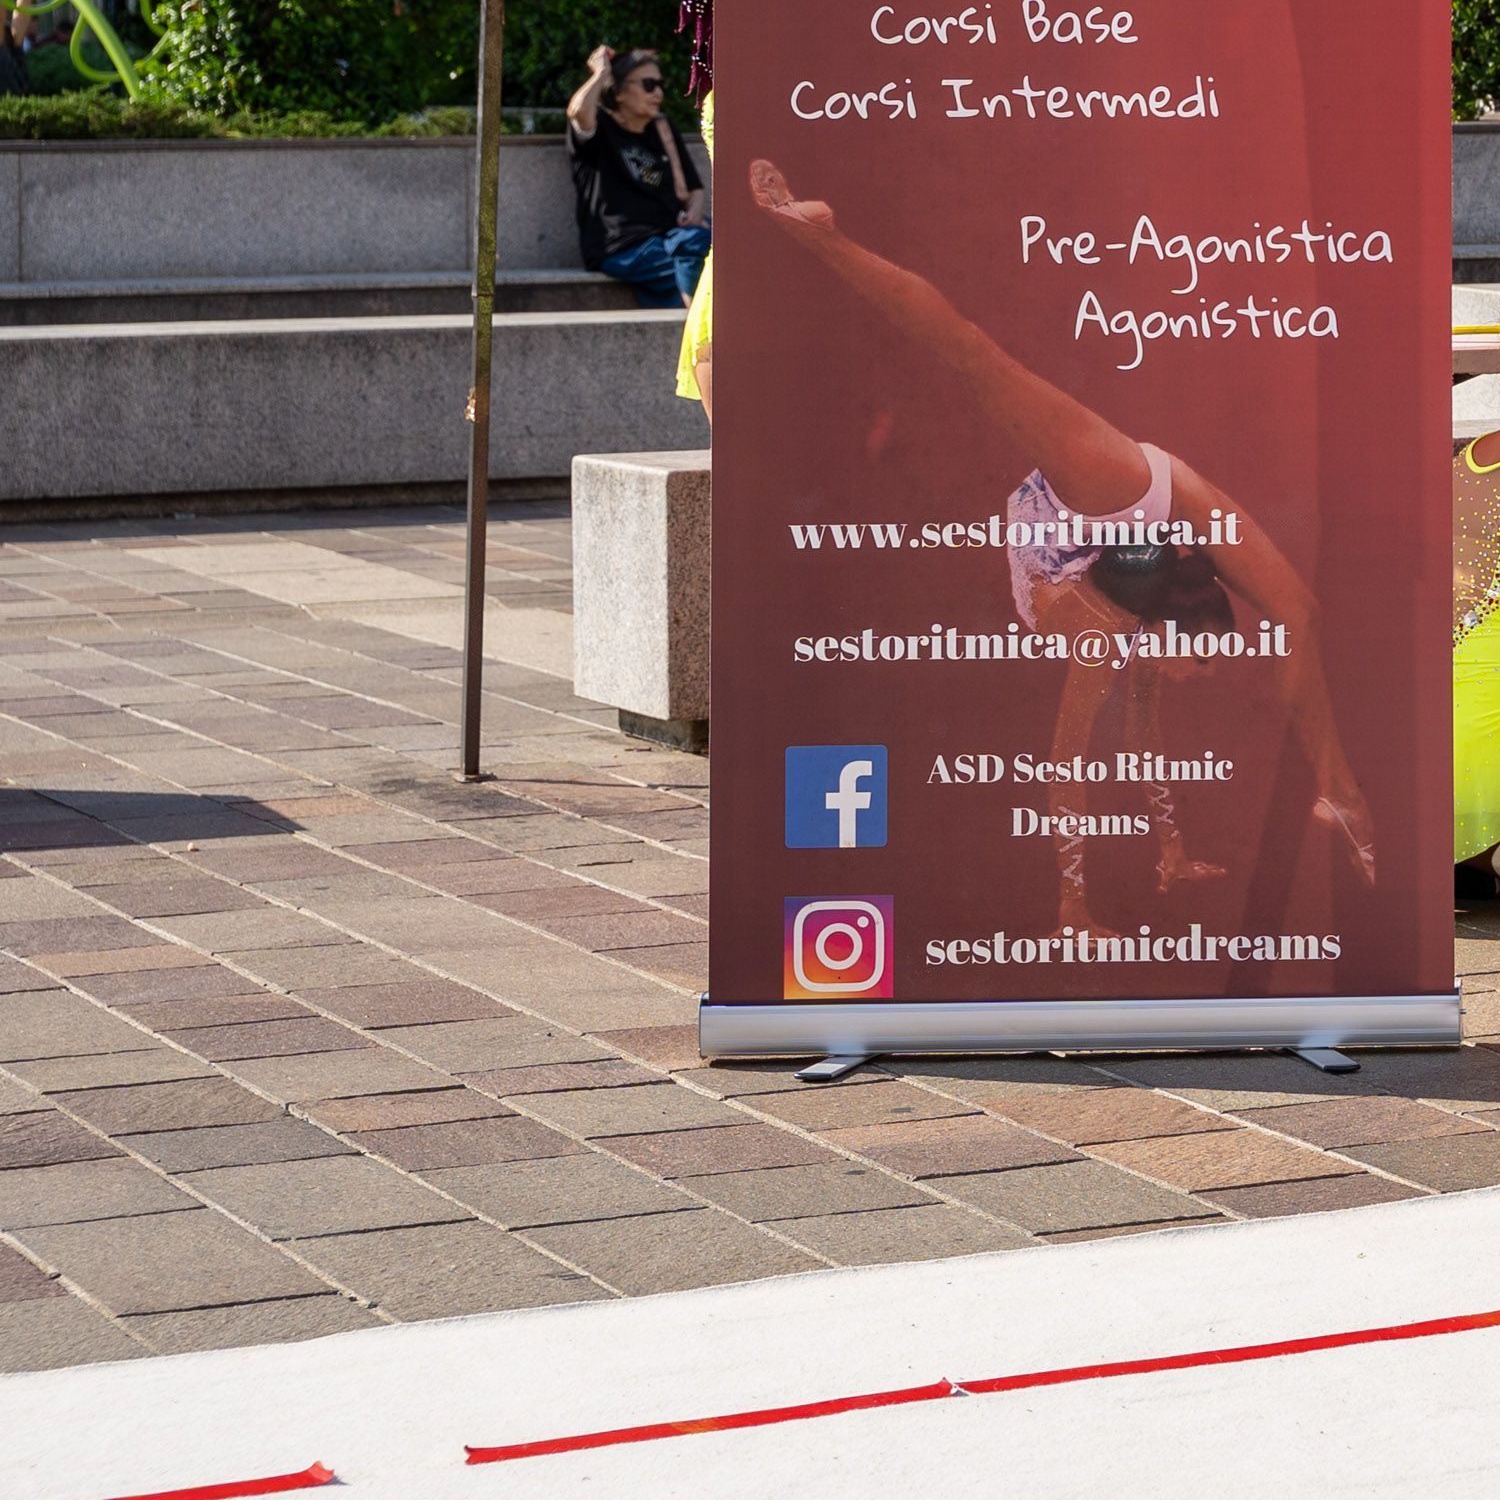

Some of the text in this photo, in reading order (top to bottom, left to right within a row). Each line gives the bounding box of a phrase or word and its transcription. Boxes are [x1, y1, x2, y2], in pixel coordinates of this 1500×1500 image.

[870, 3, 997, 45] Corsi
[790, 75, 1220, 120] Corsi Intermedi
[1020, 215, 1394, 294] Pre-Agonistica
[1074, 290, 1339, 371] Agonistica
[788, 509, 1244, 550] www.sestoritmica.it
[793, 619, 1292, 670] sestoritmica@yahoo.it
[926, 750, 1234, 785] ASD Sesto Ritmic
[1010, 807, 1150, 837] Dreams
[925, 923, 1341, 966] sestoritmicdreams
